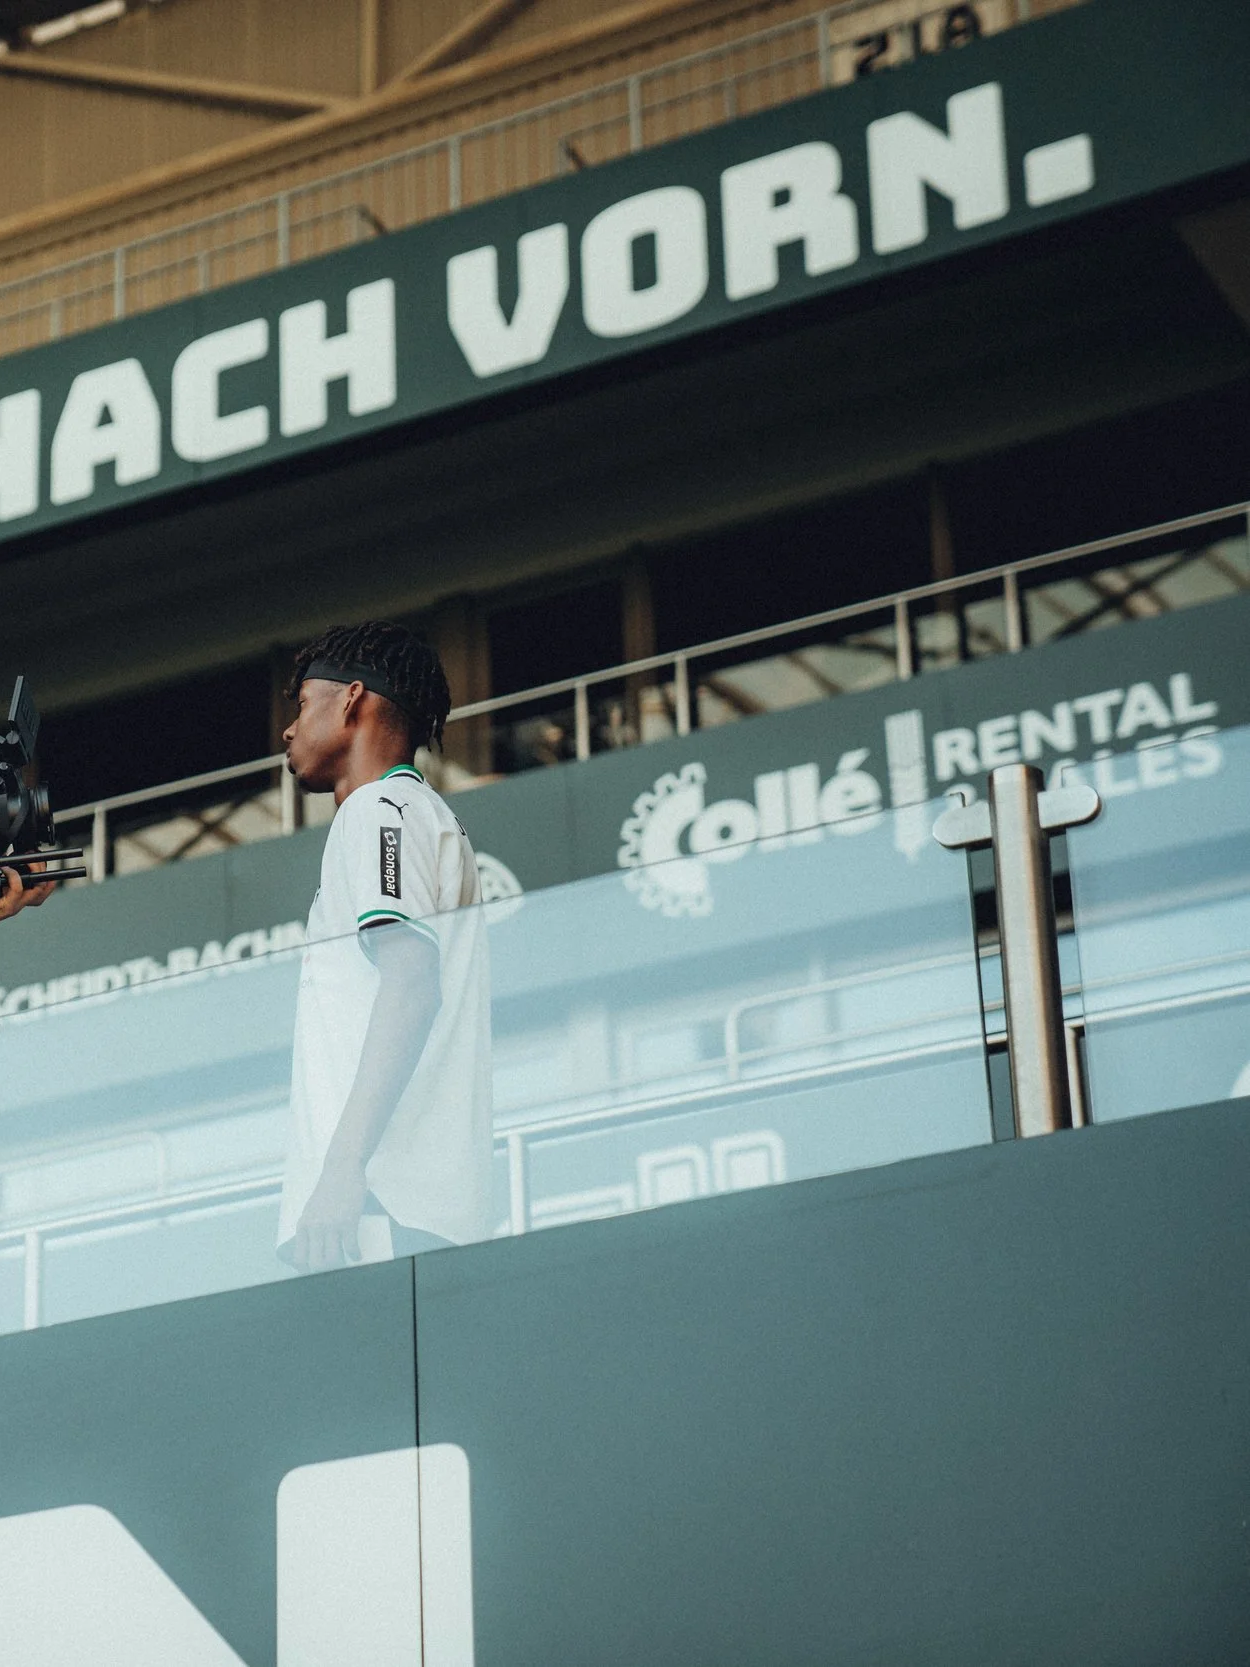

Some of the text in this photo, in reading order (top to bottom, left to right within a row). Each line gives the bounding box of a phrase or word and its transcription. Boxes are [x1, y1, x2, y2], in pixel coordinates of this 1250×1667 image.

[445, 82, 1093, 378] VORN.
[932, 672, 1221, 782] RENTAL
[1047, 724, 1225, 804] ALES
[384, 846, 397, 896] sonepar
